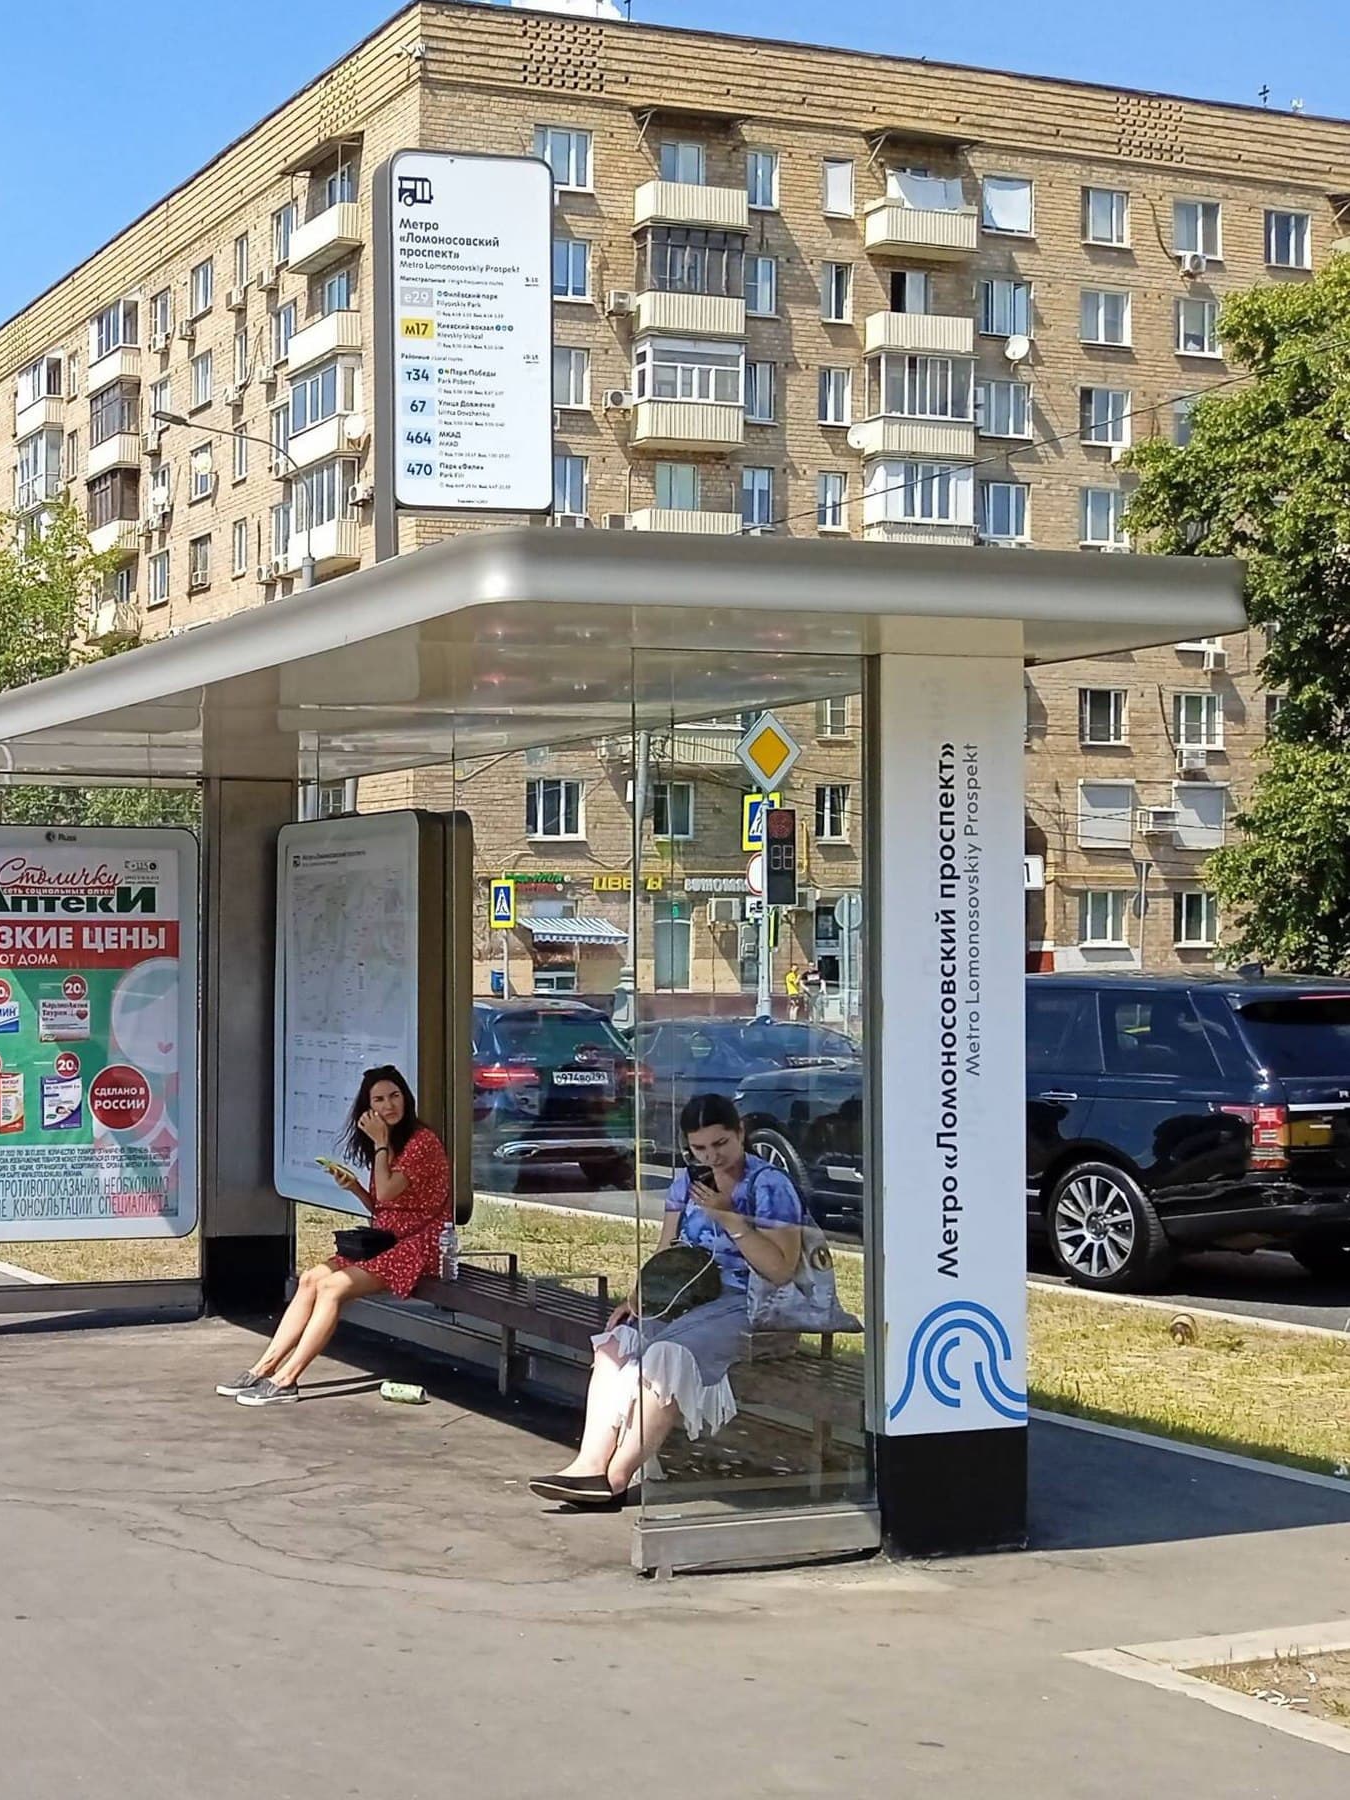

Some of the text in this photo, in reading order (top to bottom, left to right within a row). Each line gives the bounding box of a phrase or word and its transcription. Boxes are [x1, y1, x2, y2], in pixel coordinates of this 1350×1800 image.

[399, 217, 439, 232] Метро
[399, 232, 500, 248] «Ломоносовский
[399, 247, 460, 259] проспект»
[409, 399, 426, 413] 67
[406, 431, 432, 445] 464
[406, 463, 433, 476] 470
[593, 876, 663, 891] ЦВЕЫ
[962, 742, 982, 1076] Metro Lomonosovskiy Prospekt
[82, 927, 166, 953] ЦЕНЫ
[17, 953, 58, 966] ДОМА
[935, 742, 963, 1279] Метро «Ломоносовский проспект»
[94, 1087, 146, 1097] СДЕЛАНО В
[93, 1099, 146, 1110] РОССИИ
[104, 1175, 170, 1195] НЕОБХОДИМО
[13, 1197, 92, 1217] КОНСУЛЬТАЦИИ
[98, 1194, 170, 1215] СПЕЦИАЛИСТА
